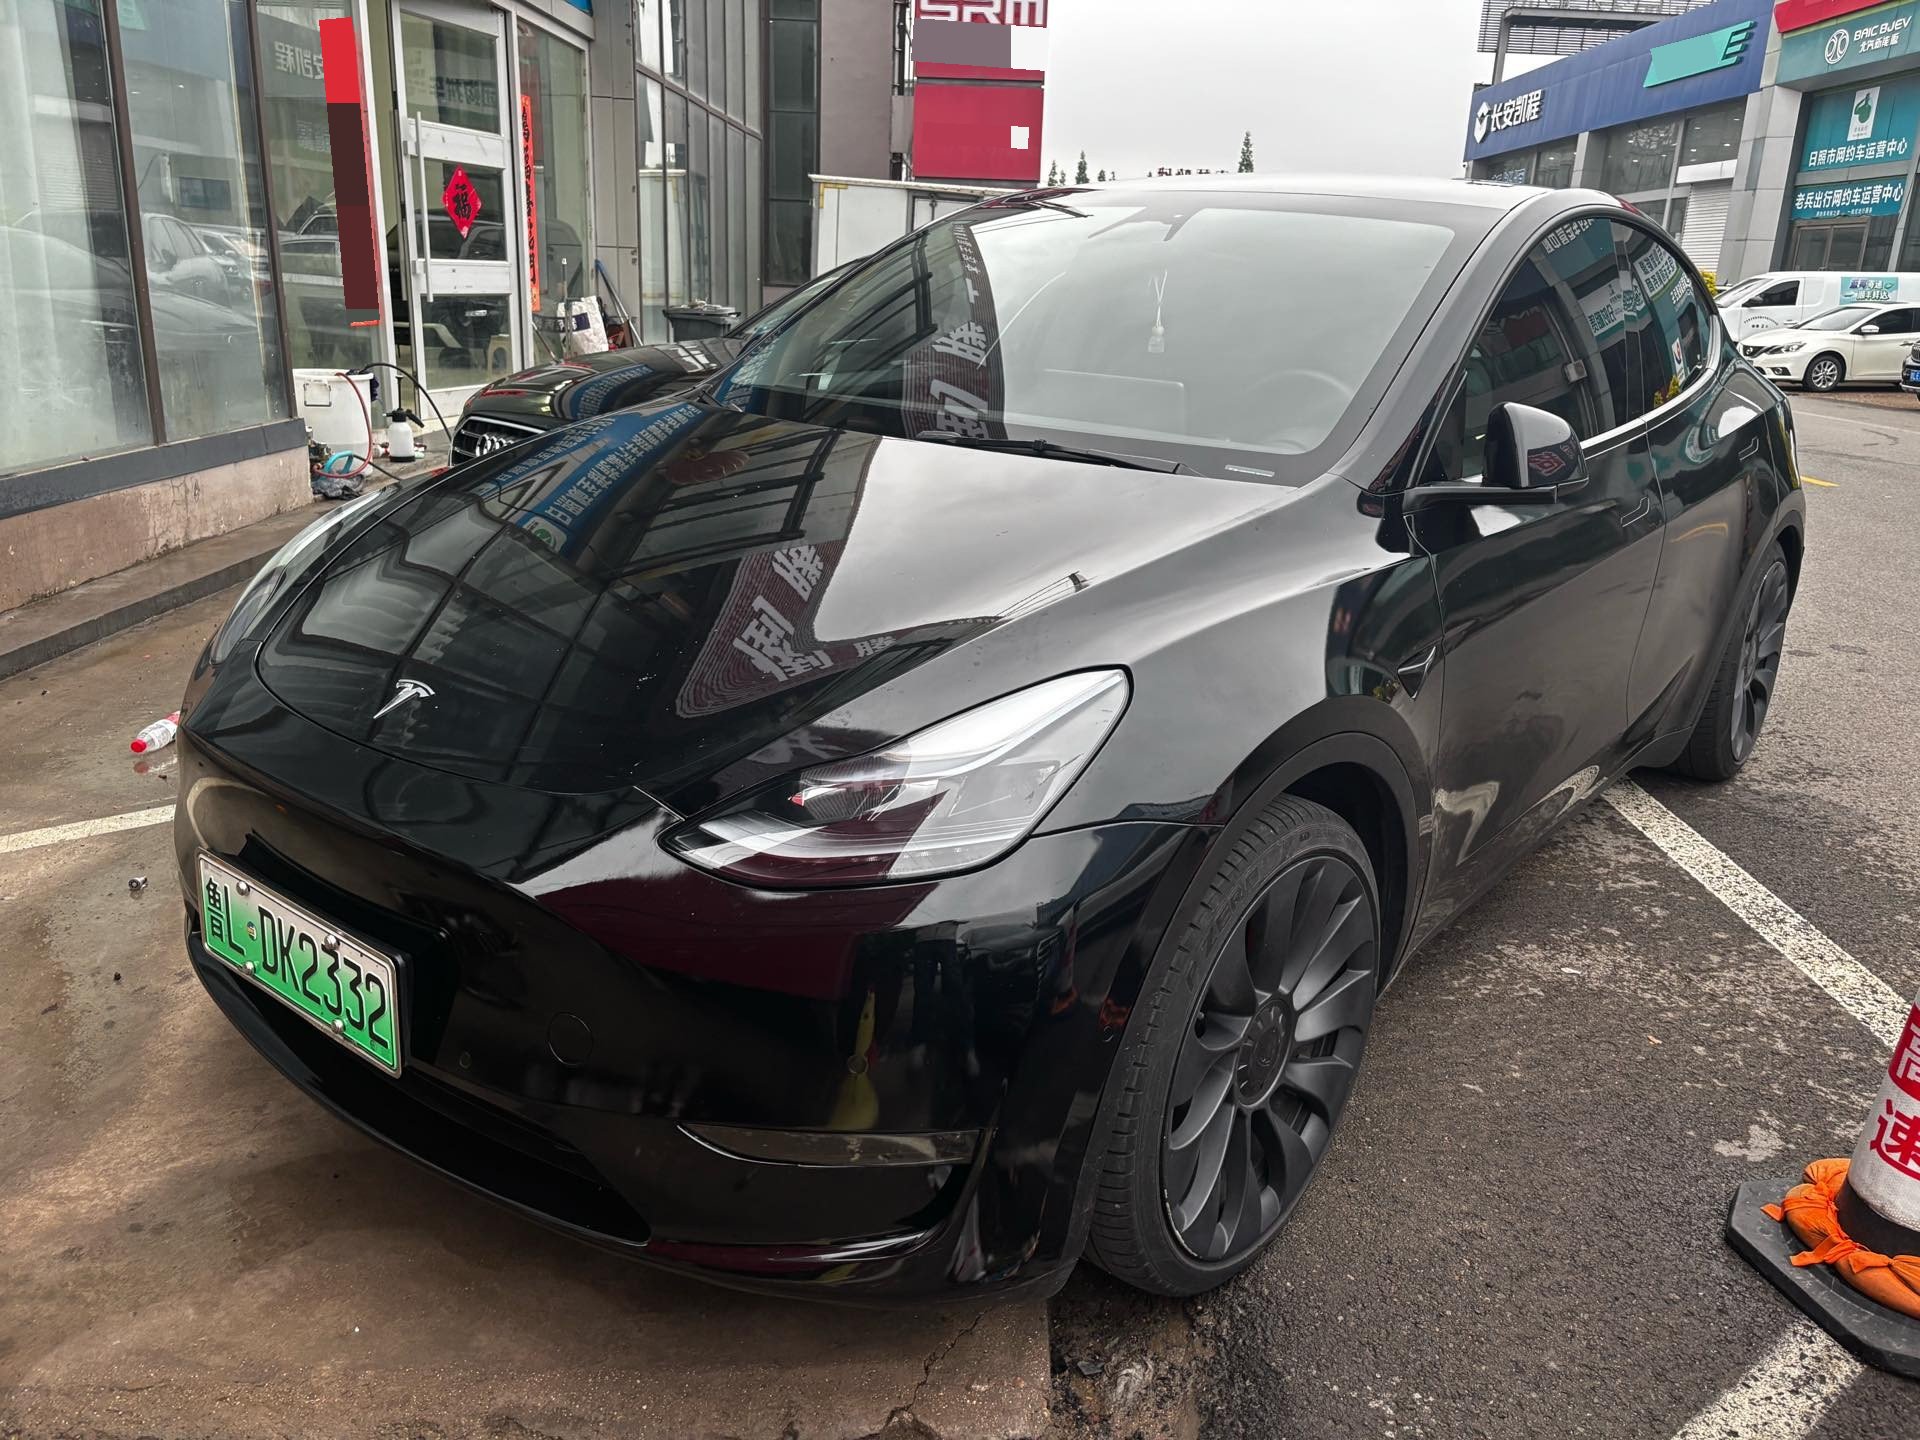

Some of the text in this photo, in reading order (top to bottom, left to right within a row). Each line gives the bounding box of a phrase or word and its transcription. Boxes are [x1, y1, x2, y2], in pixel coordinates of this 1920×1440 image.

[1854, 16, 1912, 41] BAIC BJEV
[1490, 89, 1542, 132] 长安凯程
[1808, 137, 1908, 167] 日照市网约车运营中心
[1795, 182, 1904, 209] 老兵出行网约车运营中心
